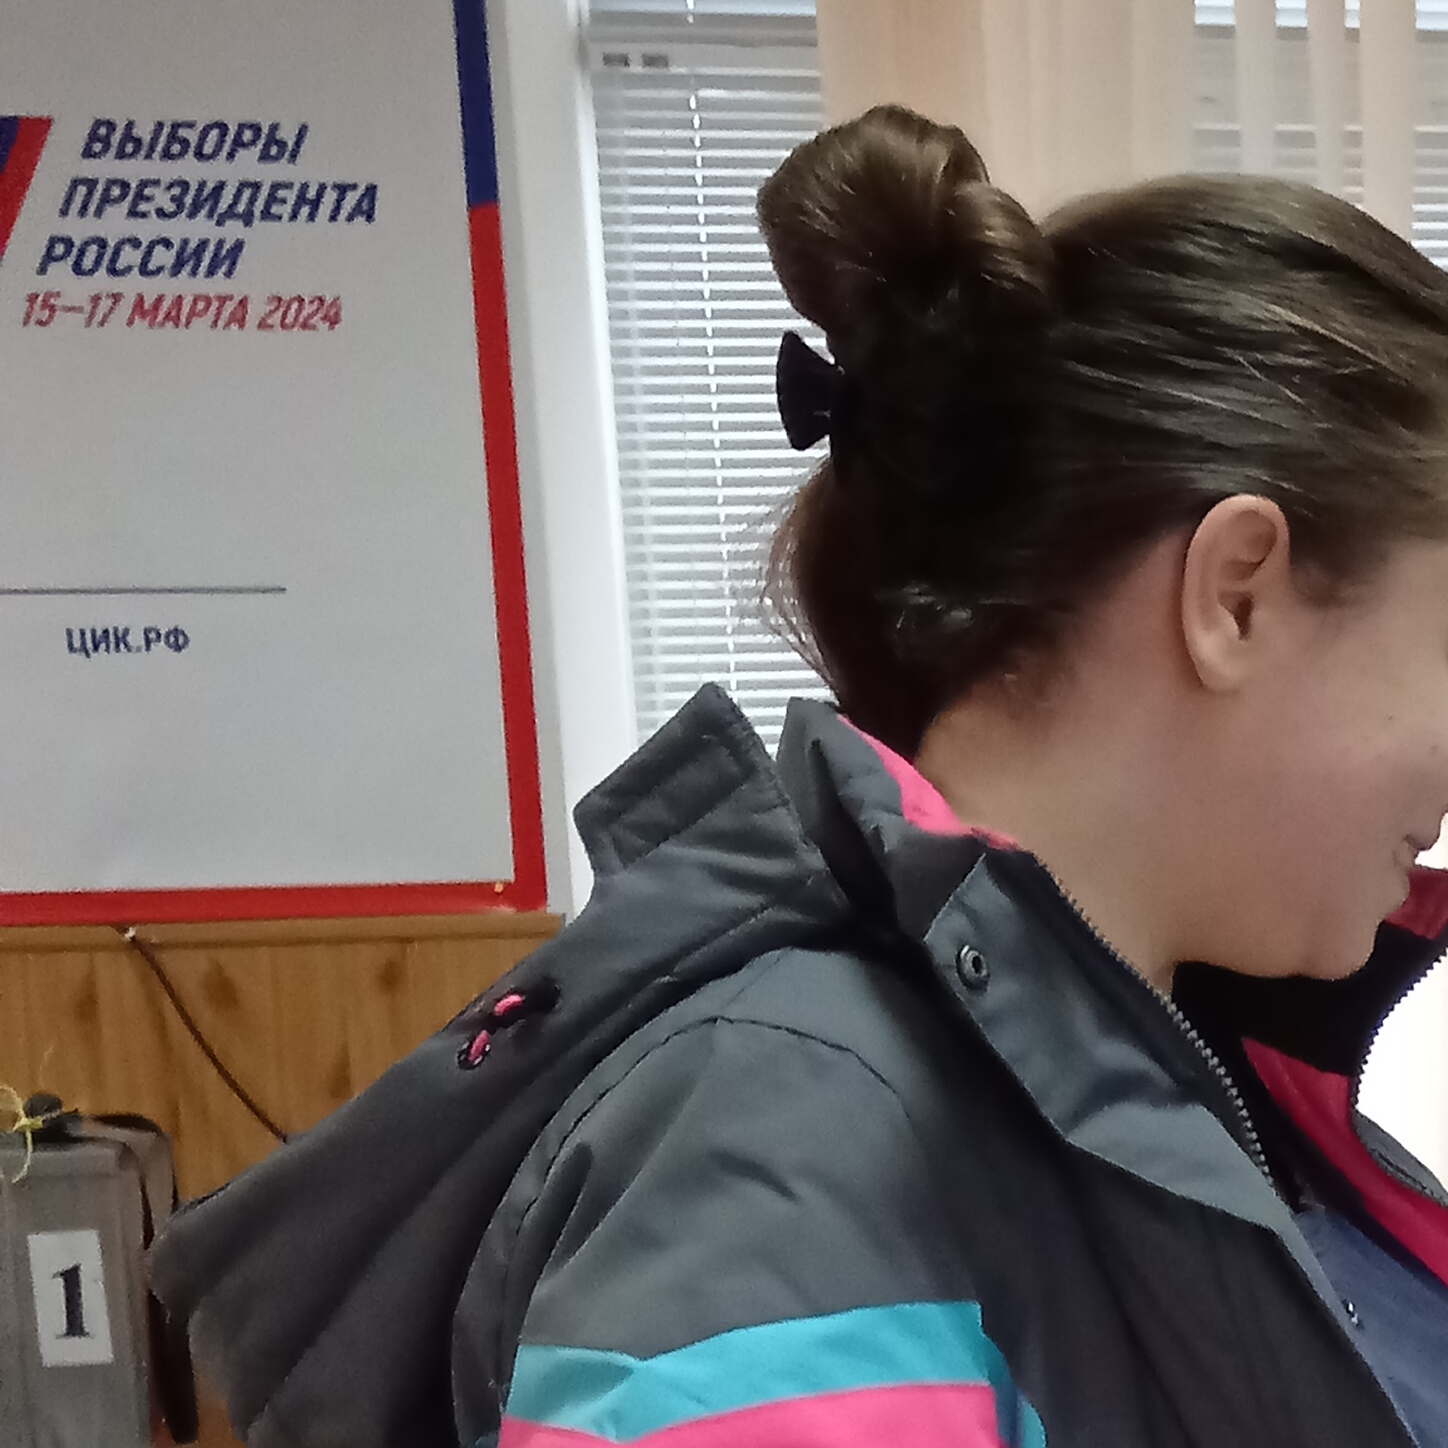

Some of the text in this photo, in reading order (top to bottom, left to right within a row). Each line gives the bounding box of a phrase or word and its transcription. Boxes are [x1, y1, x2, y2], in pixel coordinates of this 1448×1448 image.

[80, 117, 308, 166] ВЫБОРЫ
[58, 177, 379, 227] ПРЕЗИДЕНТА
[35, 234, 246, 280] РОССИИ
[126, 293, 251, 331] МАРТА
[257, 295, 343, 332] 2024
[65, 625, 190, 658] ЦИК.РФ
[51, 1262, 92, 1340] 1
